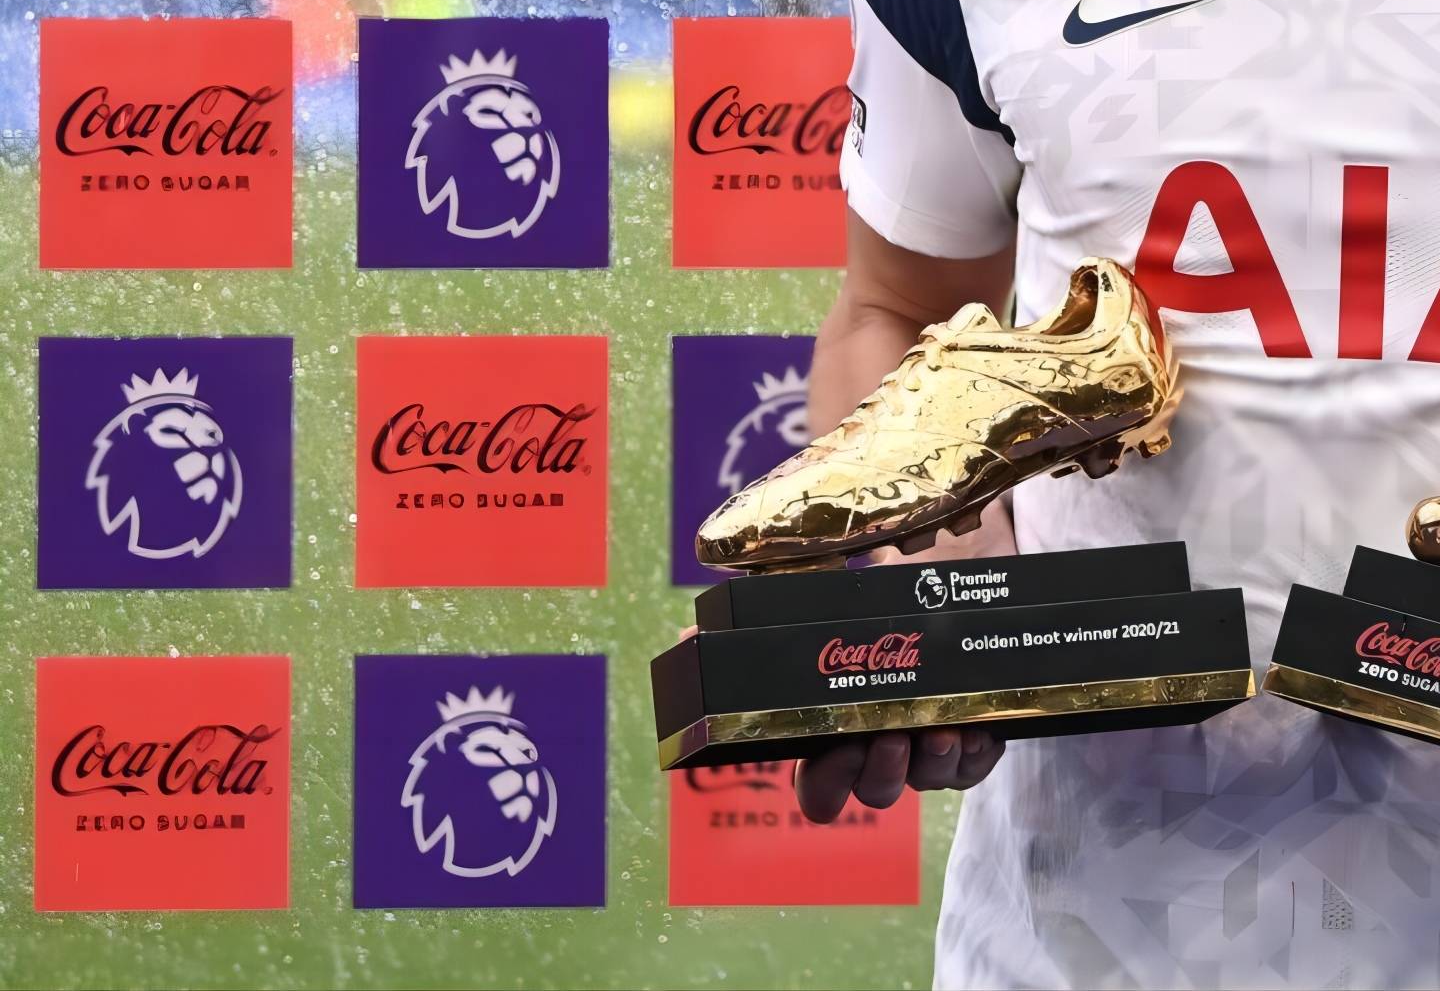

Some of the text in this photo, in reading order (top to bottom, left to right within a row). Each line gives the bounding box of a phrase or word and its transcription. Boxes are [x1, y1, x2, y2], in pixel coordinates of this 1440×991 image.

[54, 85, 284, 159] Coca-Cola
[687, 85, 852, 160] Coca-Co
[81, 175, 251, 193] ZERO SUGAR
[712, 174, 782, 192] ZERO
[370, 404, 599, 477] Coca-Cola
[396, 493, 565, 511] ZERO SUGAR
[950, 570, 1008, 587] Premier
[951, 584, 1010, 602] League
[961, 620, 1180, 652] Golden Boot winner 2020/21
[817, 631, 924, 675] Coca-Cola
[828, 670, 917, 689] zero SUGAR
[1357, 660, 1399, 683] zero
[50, 725, 281, 799] Coca-Cola
[77, 814, 247, 833] ZERO SUGAR
[710, 811, 779, 829] ZERO
